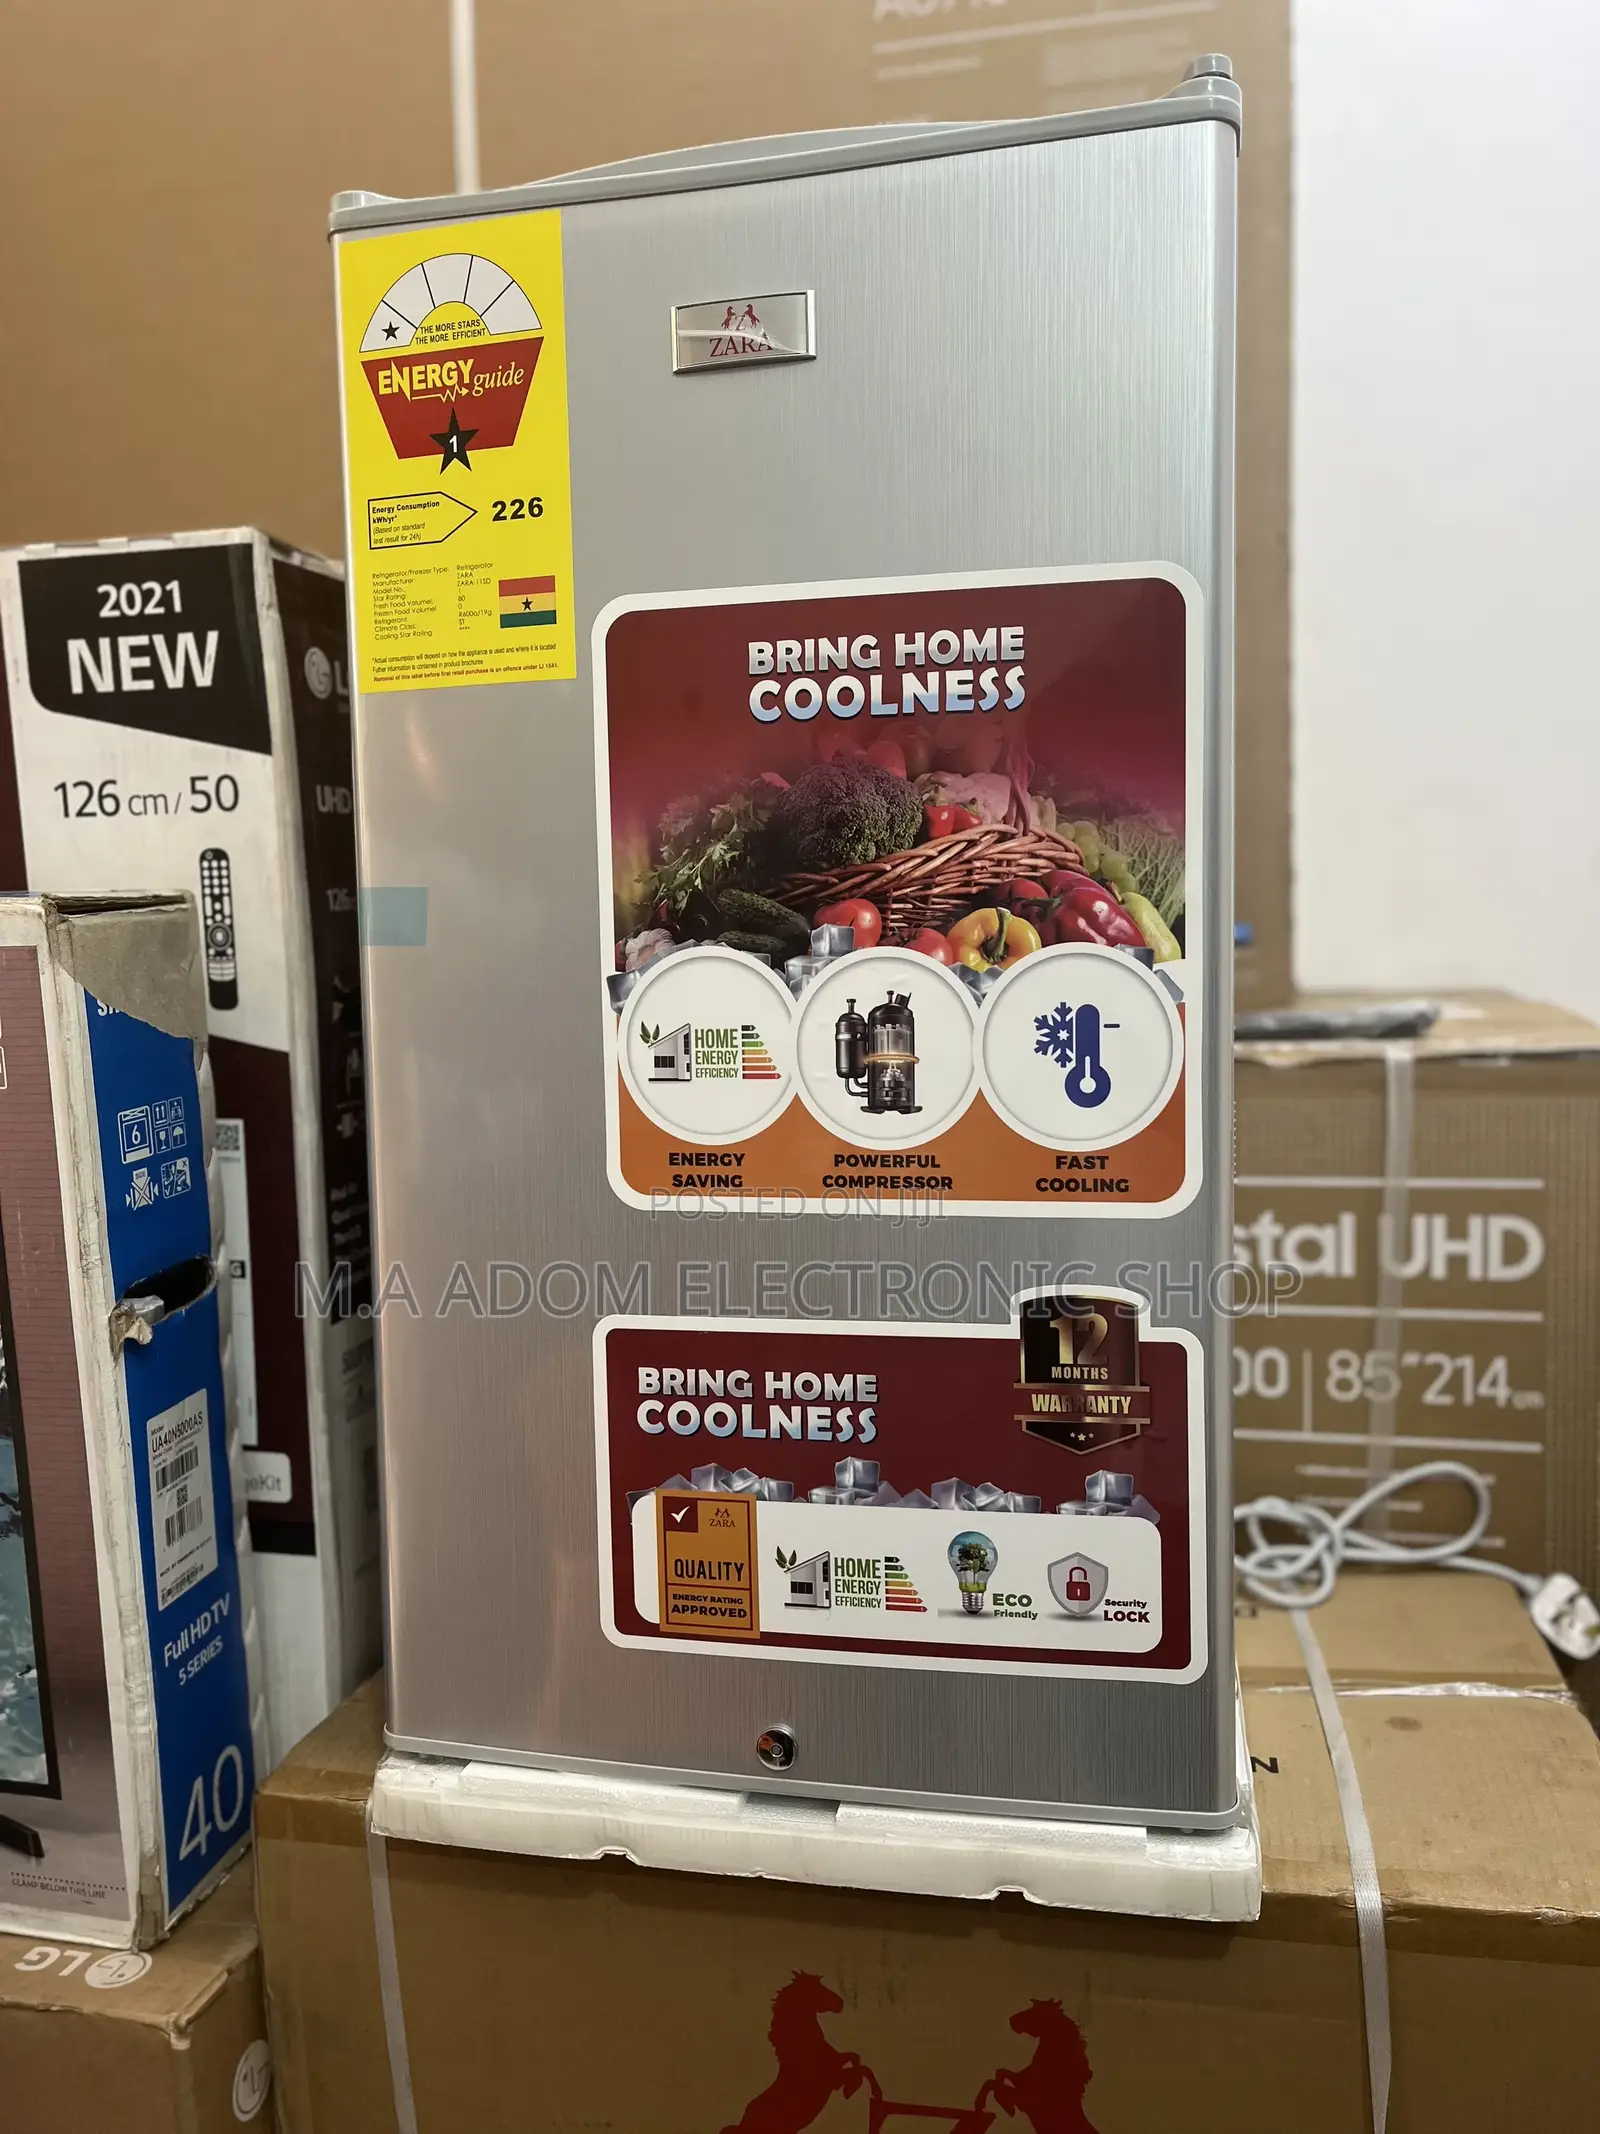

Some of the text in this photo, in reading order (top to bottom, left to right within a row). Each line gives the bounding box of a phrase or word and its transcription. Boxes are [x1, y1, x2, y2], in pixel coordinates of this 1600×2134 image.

[420, 319, 481, 334] THE MORE STARS
[415, 328, 486, 345] THE MORE EFFICIENT
[378, 358, 525, 402] ENERGY guide
[449, 434, 458, 453] 1
[372, 501, 440, 514] Energy Consumption
[491, 496, 544, 522] 226
[401, 522, 426, 531] standard
[384, 535, 399, 543] result
[456, 562, 493, 571] Refrigerator
[457, 571, 474, 580] ZARA
[97, 579, 183, 618] 2021
[373, 587, 392, 595] Model
[748, 626, 1025, 675] BRING HOME
[66, 629, 219, 695] NEW
[465, 668, 489, 676] purchase
[748, 665, 1026, 722] COOLNESS
[53, 778, 121, 818] 126
[189, 773, 240, 814] 50
[694, 1028, 739, 1049] HOME
[695, 1050, 739, 1065] ENERGY
[695, 1067, 739, 1079] EFFICIENCY
[131, 1124, 141, 1145] 6
[668, 1152, 746, 1167] ENERGY
[833, 1153, 941, 1168] POWERFUL
[1055, 1155, 1110, 1170] FAST
[671, 1173, 744, 1188] SAVING
[822, 1174, 953, 1190] COMPRESSOR
[1035, 1177, 1130, 1194] COOLING
[1378, 1212, 1546, 1283] UHD
[1050, 1313, 1110, 1366] 12
[1051, 1366, 1109, 1380] MONTHS
[637, 1366, 878, 1403] BRING HOME
[1031, 1393, 1132, 1415] WARRANTY
[636, 1399, 878, 1444] COOLNESS
[151, 1410, 203, 1453] UA40N5000AS
[709, 1518, 736, 1528] ZARA
[674, 1558, 745, 1582] QUALITY
[833, 1556, 882, 1580] HOME
[834, 1579, 882, 1596] ENERGY
[672, 1593, 744, 1605] ENERGY RATING
[834, 1595, 882, 1609] EFFICIENCY
[992, 1592, 1033, 1609] ECO
[1104, 1598, 1148, 1609] Security
[671, 1603, 748, 1619] APPROVED
[993, 1608, 1039, 1621] Friendly
[1103, 1610, 1151, 1624] LOCK
[164, 1592, 230, 1668] Full HD TV
[179, 1634, 223, 1686] 5 SERIES
[179, 1744, 245, 1862] 40
[11, 1878, 107, 1899] CLAMP BELOW THIS LINE
[15, 1946, 92, 1978] LG
